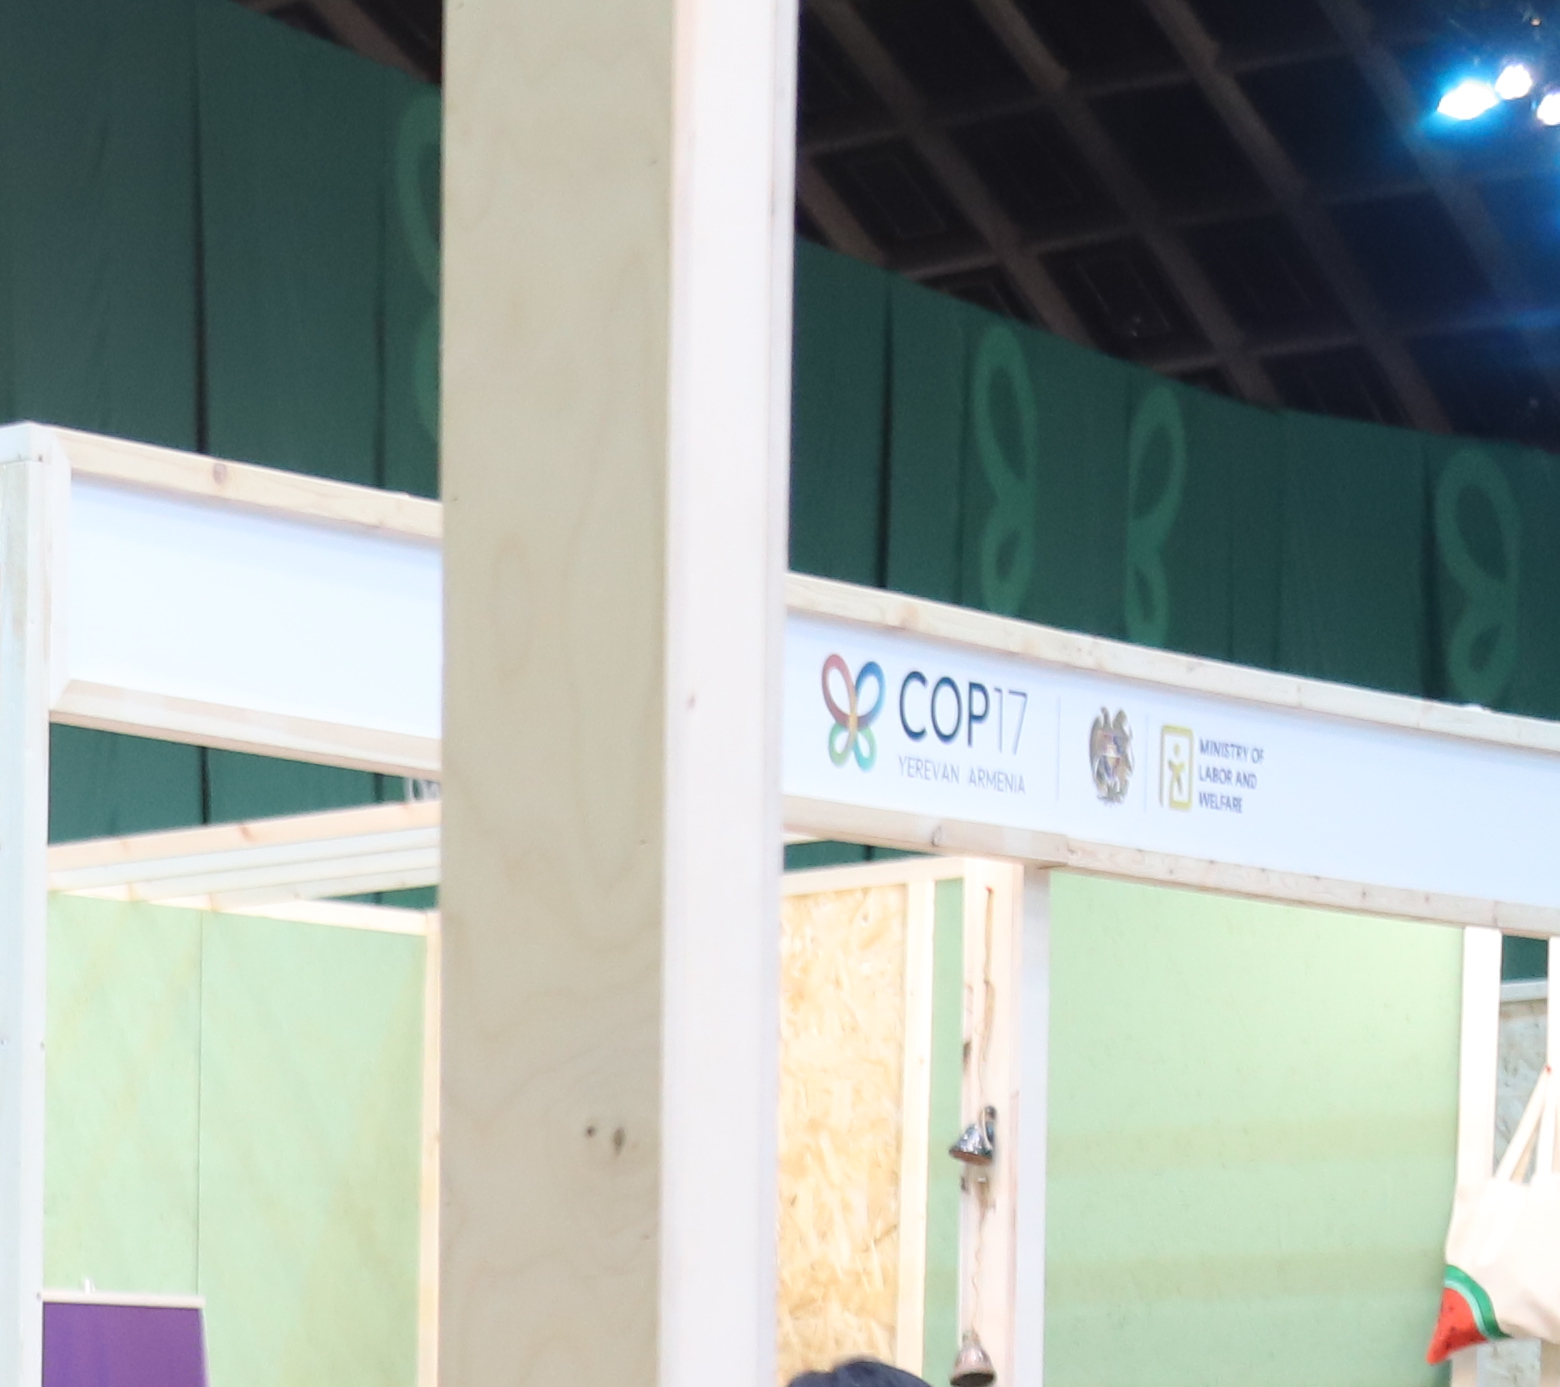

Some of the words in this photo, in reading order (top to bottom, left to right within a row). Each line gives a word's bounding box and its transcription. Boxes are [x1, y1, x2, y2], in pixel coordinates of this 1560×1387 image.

[899, 670, 1028, 756] COP17
[1199, 737, 1249, 761] MINISTRY
[1251, 747, 1264, 764] OF
[898, 755, 960, 784] YEREVAN
[969, 767, 1026, 795] ARMENIA
[1199, 766, 1233, 785] LABOR
[1236, 771, 1258, 789] AND
[1199, 791, 1242, 813] WELFARE
